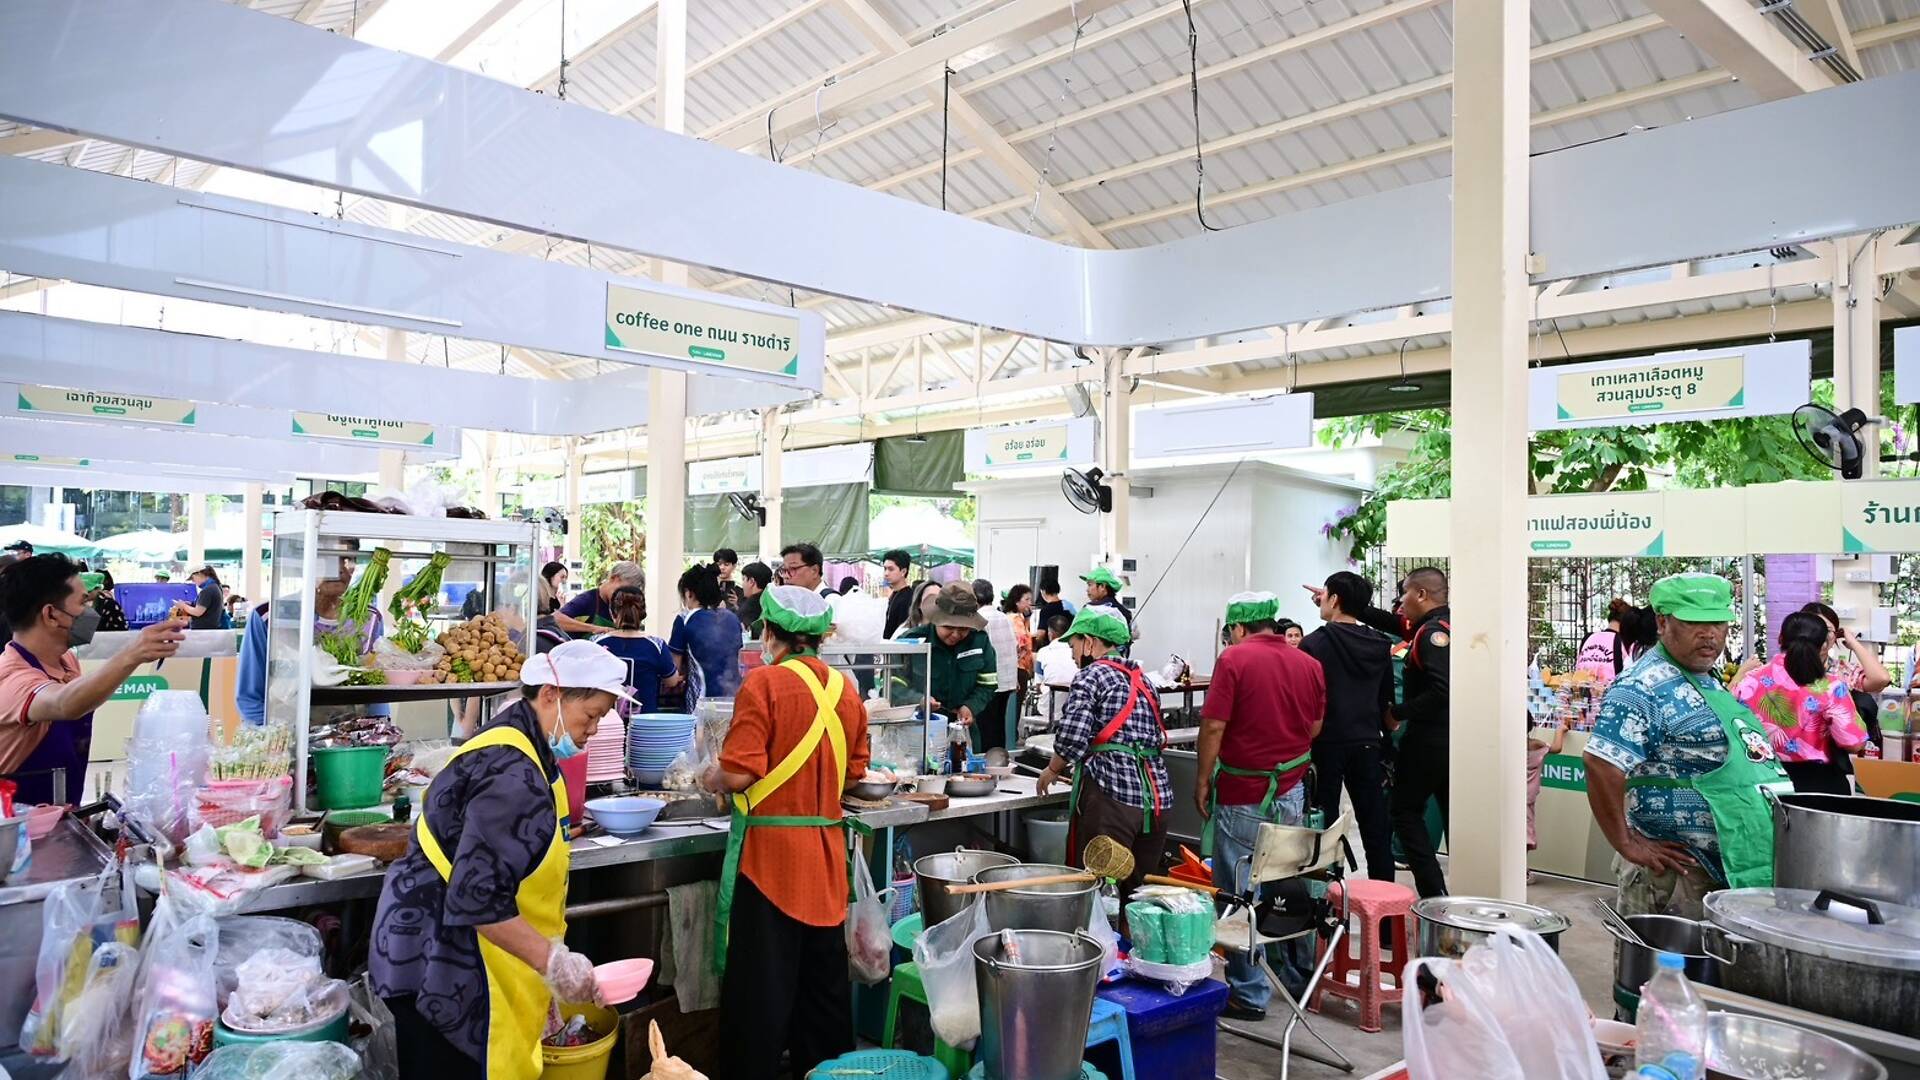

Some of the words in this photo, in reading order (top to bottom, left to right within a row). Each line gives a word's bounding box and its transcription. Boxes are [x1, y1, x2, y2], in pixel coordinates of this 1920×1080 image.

[616, 311, 669, 332] coffee
[674, 322, 703, 337] one
[708, 327, 737, 343] ถนน
[742, 333, 791, 352] ราชดำริ
[1591, 366, 1704, 387] เกาเหลาเลือดหมู
[1597, 384, 1681, 404] สวนลุมประตู
[1687, 383, 1697, 395] 8
[1527, 508, 1651, 531] าแฟสองพี่น้อง
[114, 683, 157, 694] EMAN
[1540, 764, 1572, 781] INE
